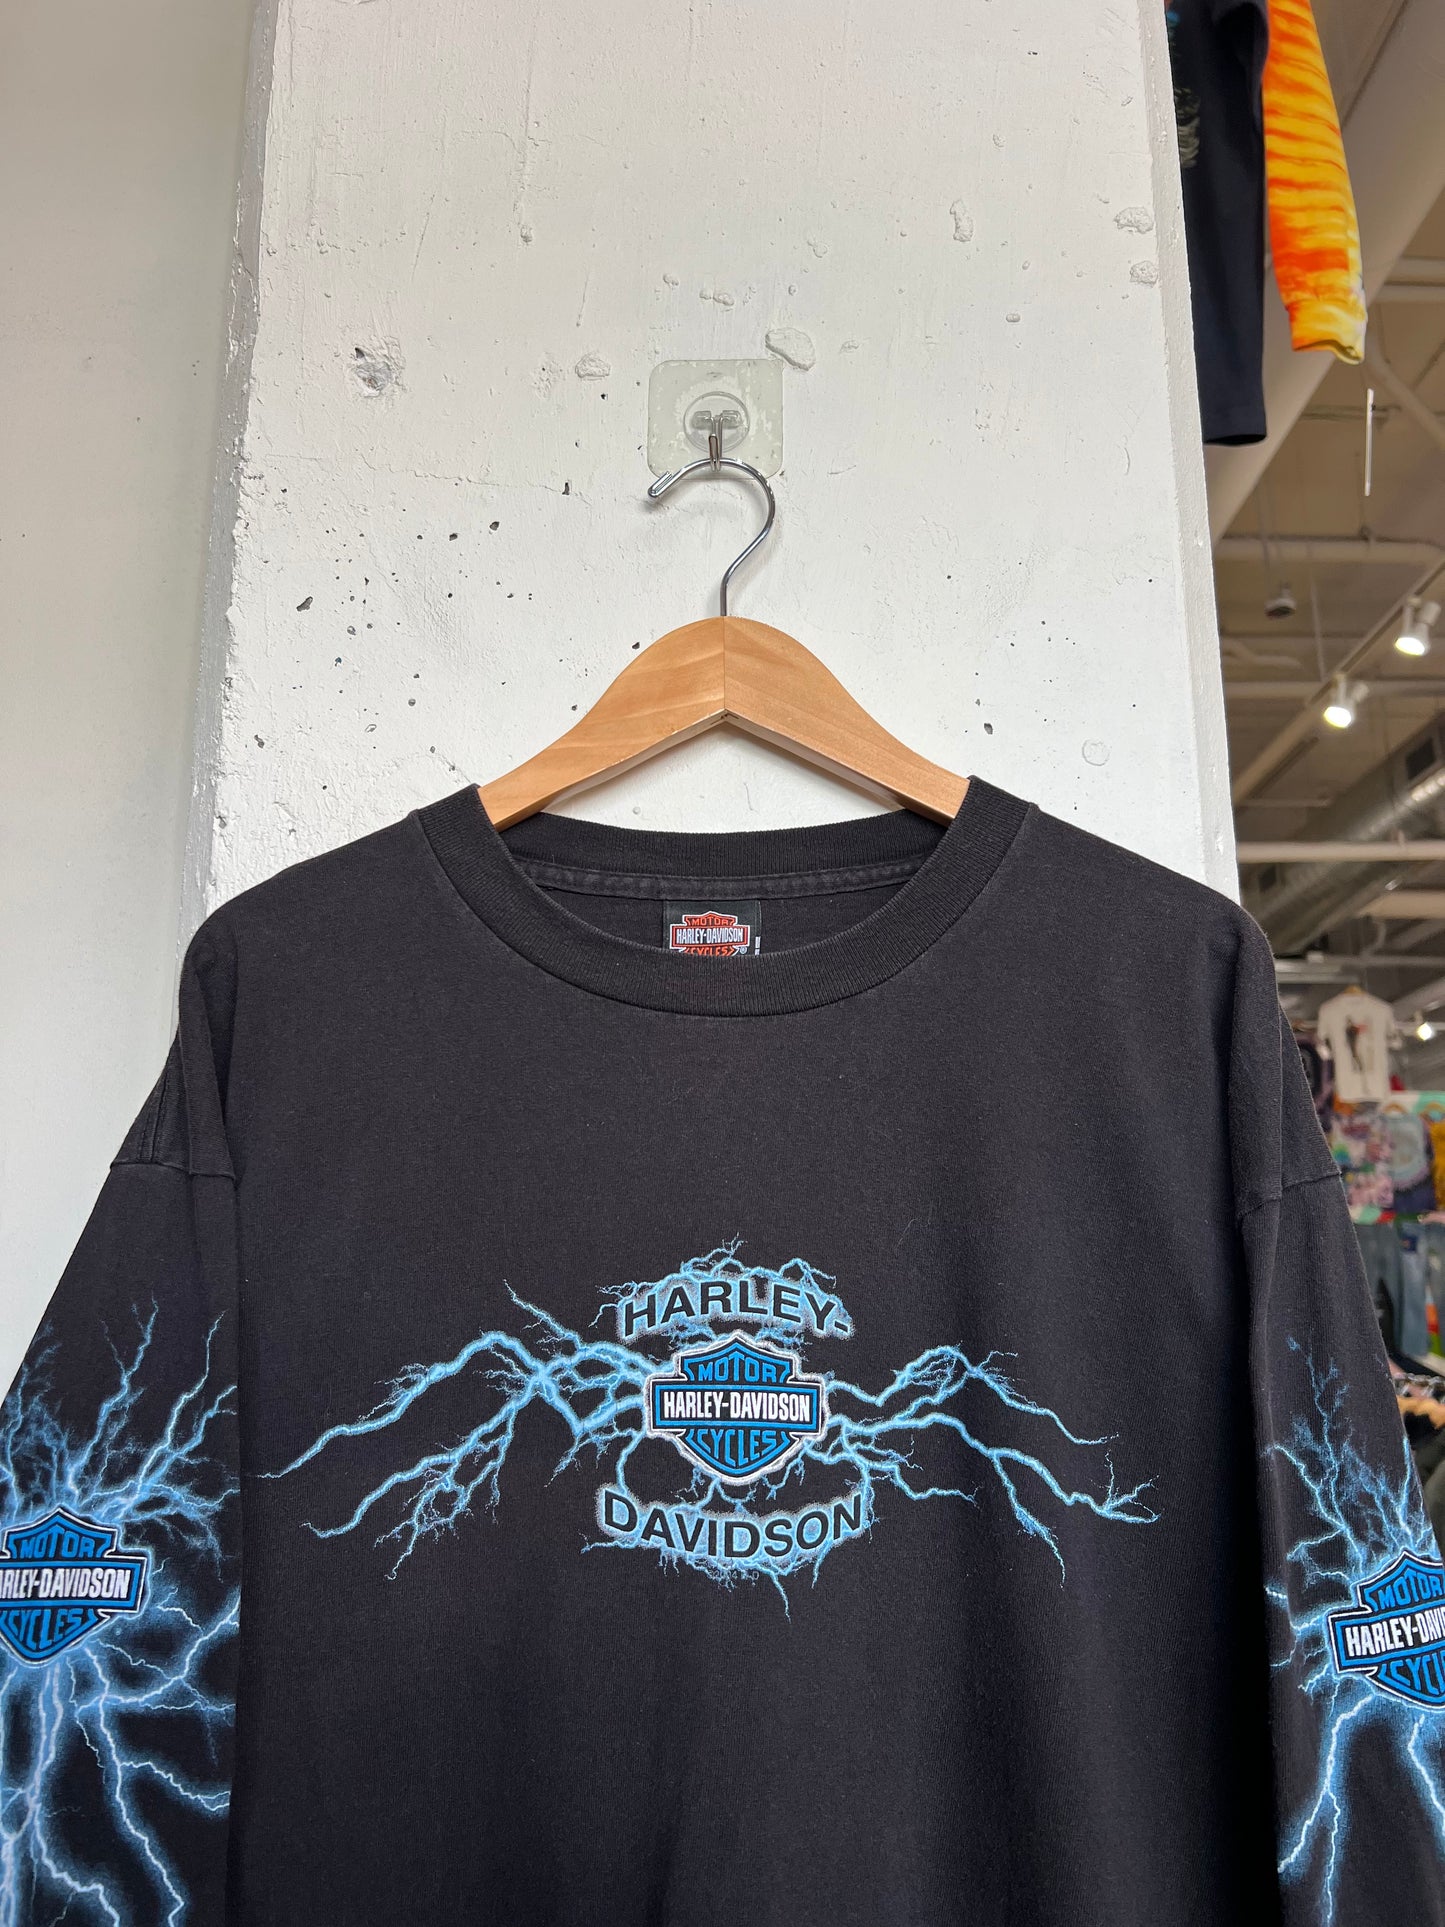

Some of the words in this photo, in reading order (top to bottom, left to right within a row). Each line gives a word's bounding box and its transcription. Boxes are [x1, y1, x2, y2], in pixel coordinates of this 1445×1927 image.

[676, 928, 744, 945] HARLEY-DAVIDSON
[691, 916, 729, 926] MOTOR
[622, 1280, 850, 1337] HARLEY-
[698, 1351, 777, 1383] MOTOR
[663, 1391, 811, 1423] HARLEY-DAVIDSON
[698, 1429, 777, 1467] CYCLES
[19, 1523, 96, 1559] MOTOR
[603, 1489, 862, 1559] DAVIDSON
[0, 1568, 131, 1599] RLEY-DAVIDSON
[1379, 1567, 1443, 1610] MOTOR
[8, 1608, 84, 1650] CYCLES
